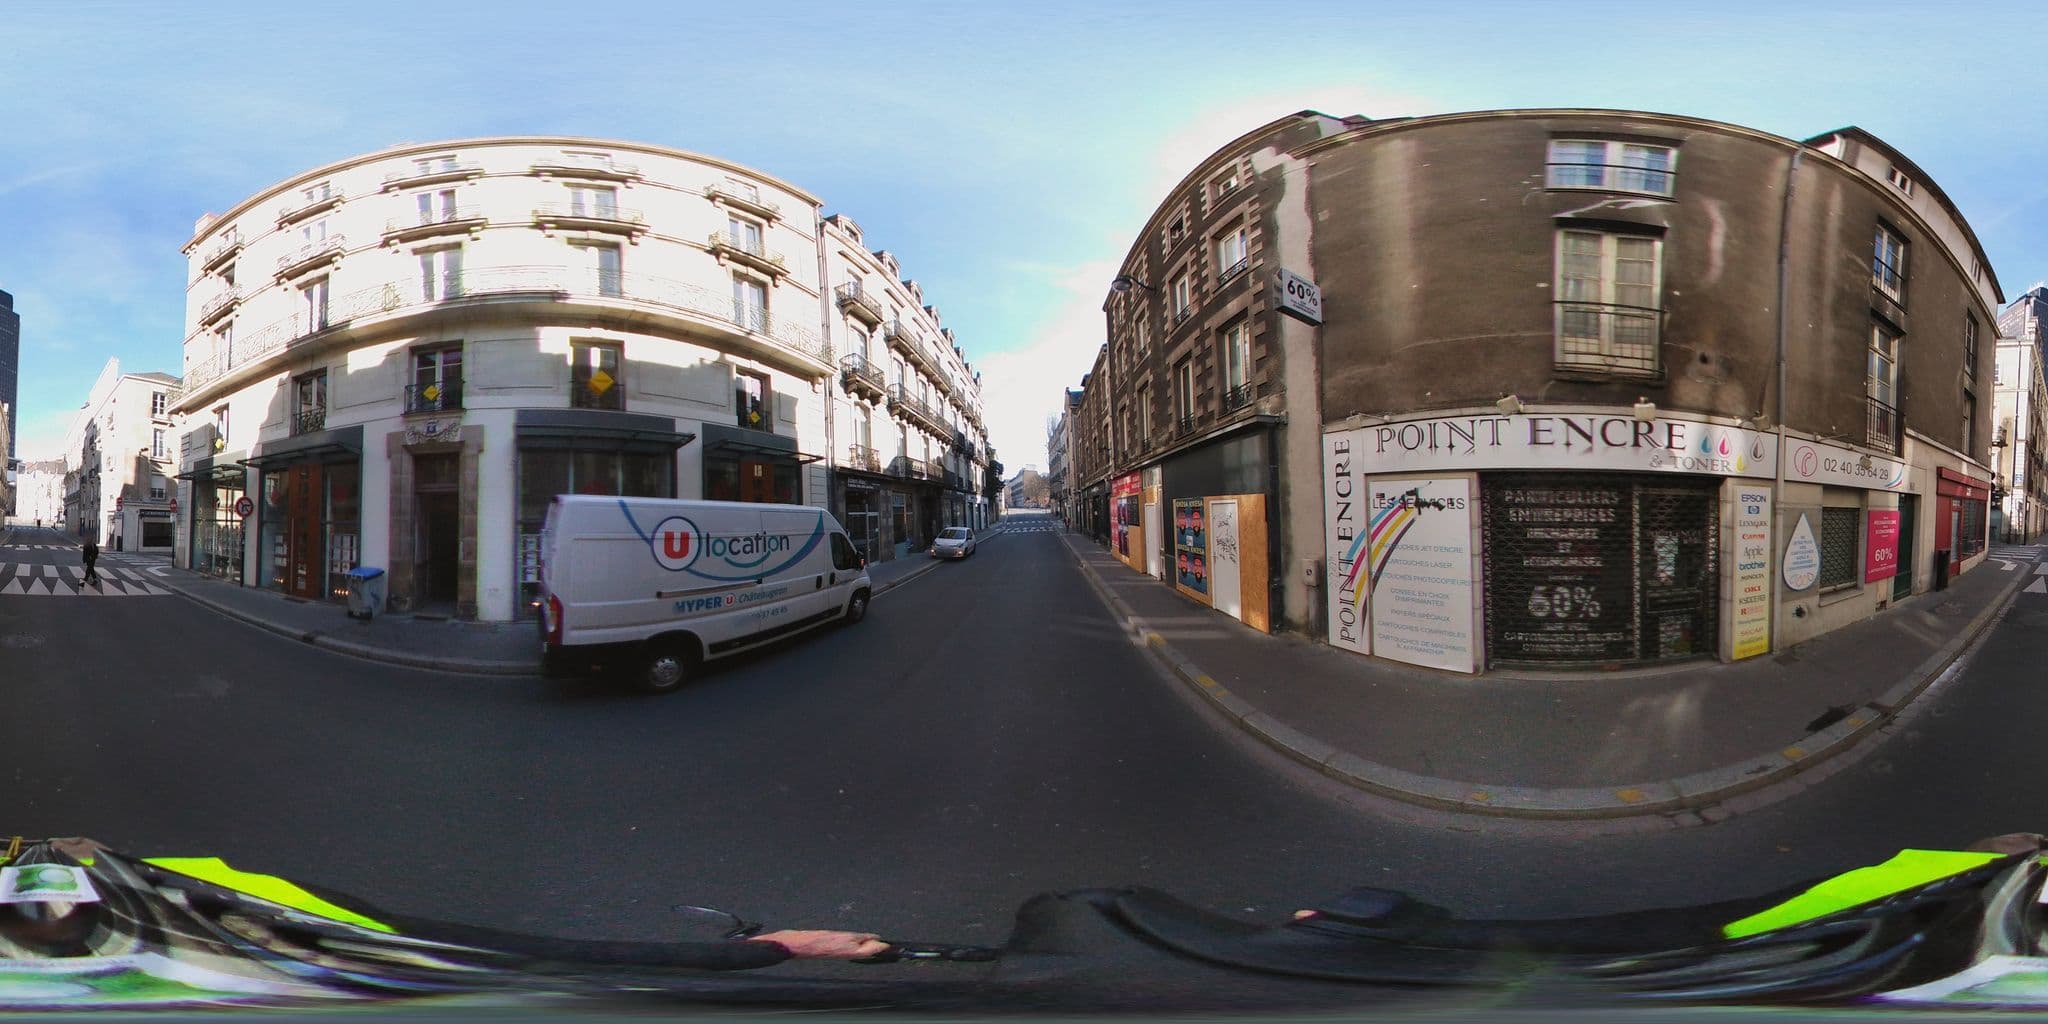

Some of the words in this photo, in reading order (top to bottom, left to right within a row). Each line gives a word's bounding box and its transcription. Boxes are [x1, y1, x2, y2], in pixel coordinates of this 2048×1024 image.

[1287, 279, 1318, 307] 60%
[1376, 418, 1510, 453] POINT
[1528, 417, 1686, 451] ENCRE
[1649, 454, 1663, 468] &
[1669, 455, 1732, 472] TONER
[1824, 457, 1837, 472] 02
[1840, 461, 1852, 475] 40
[1879, 468, 1889, 481] 29
[1334, 439, 1353, 542] ENCRE
[1741, 494, 1766, 503] EPSON
[1372, 498, 1395, 510] LES
[1398, 497, 1465, 511] SECES
[664, 531, 690, 560] U
[705, 531, 790, 558] location
[1378, 542, 1420, 552] AOUCHES
[1874, 547, 1893, 562] 60%
[1739, 562, 1766, 571] brother
[674, 596, 722, 614] HYPER
[1338, 551, 1356, 644] POINT
[1528, 585, 1601, 618] 60%
